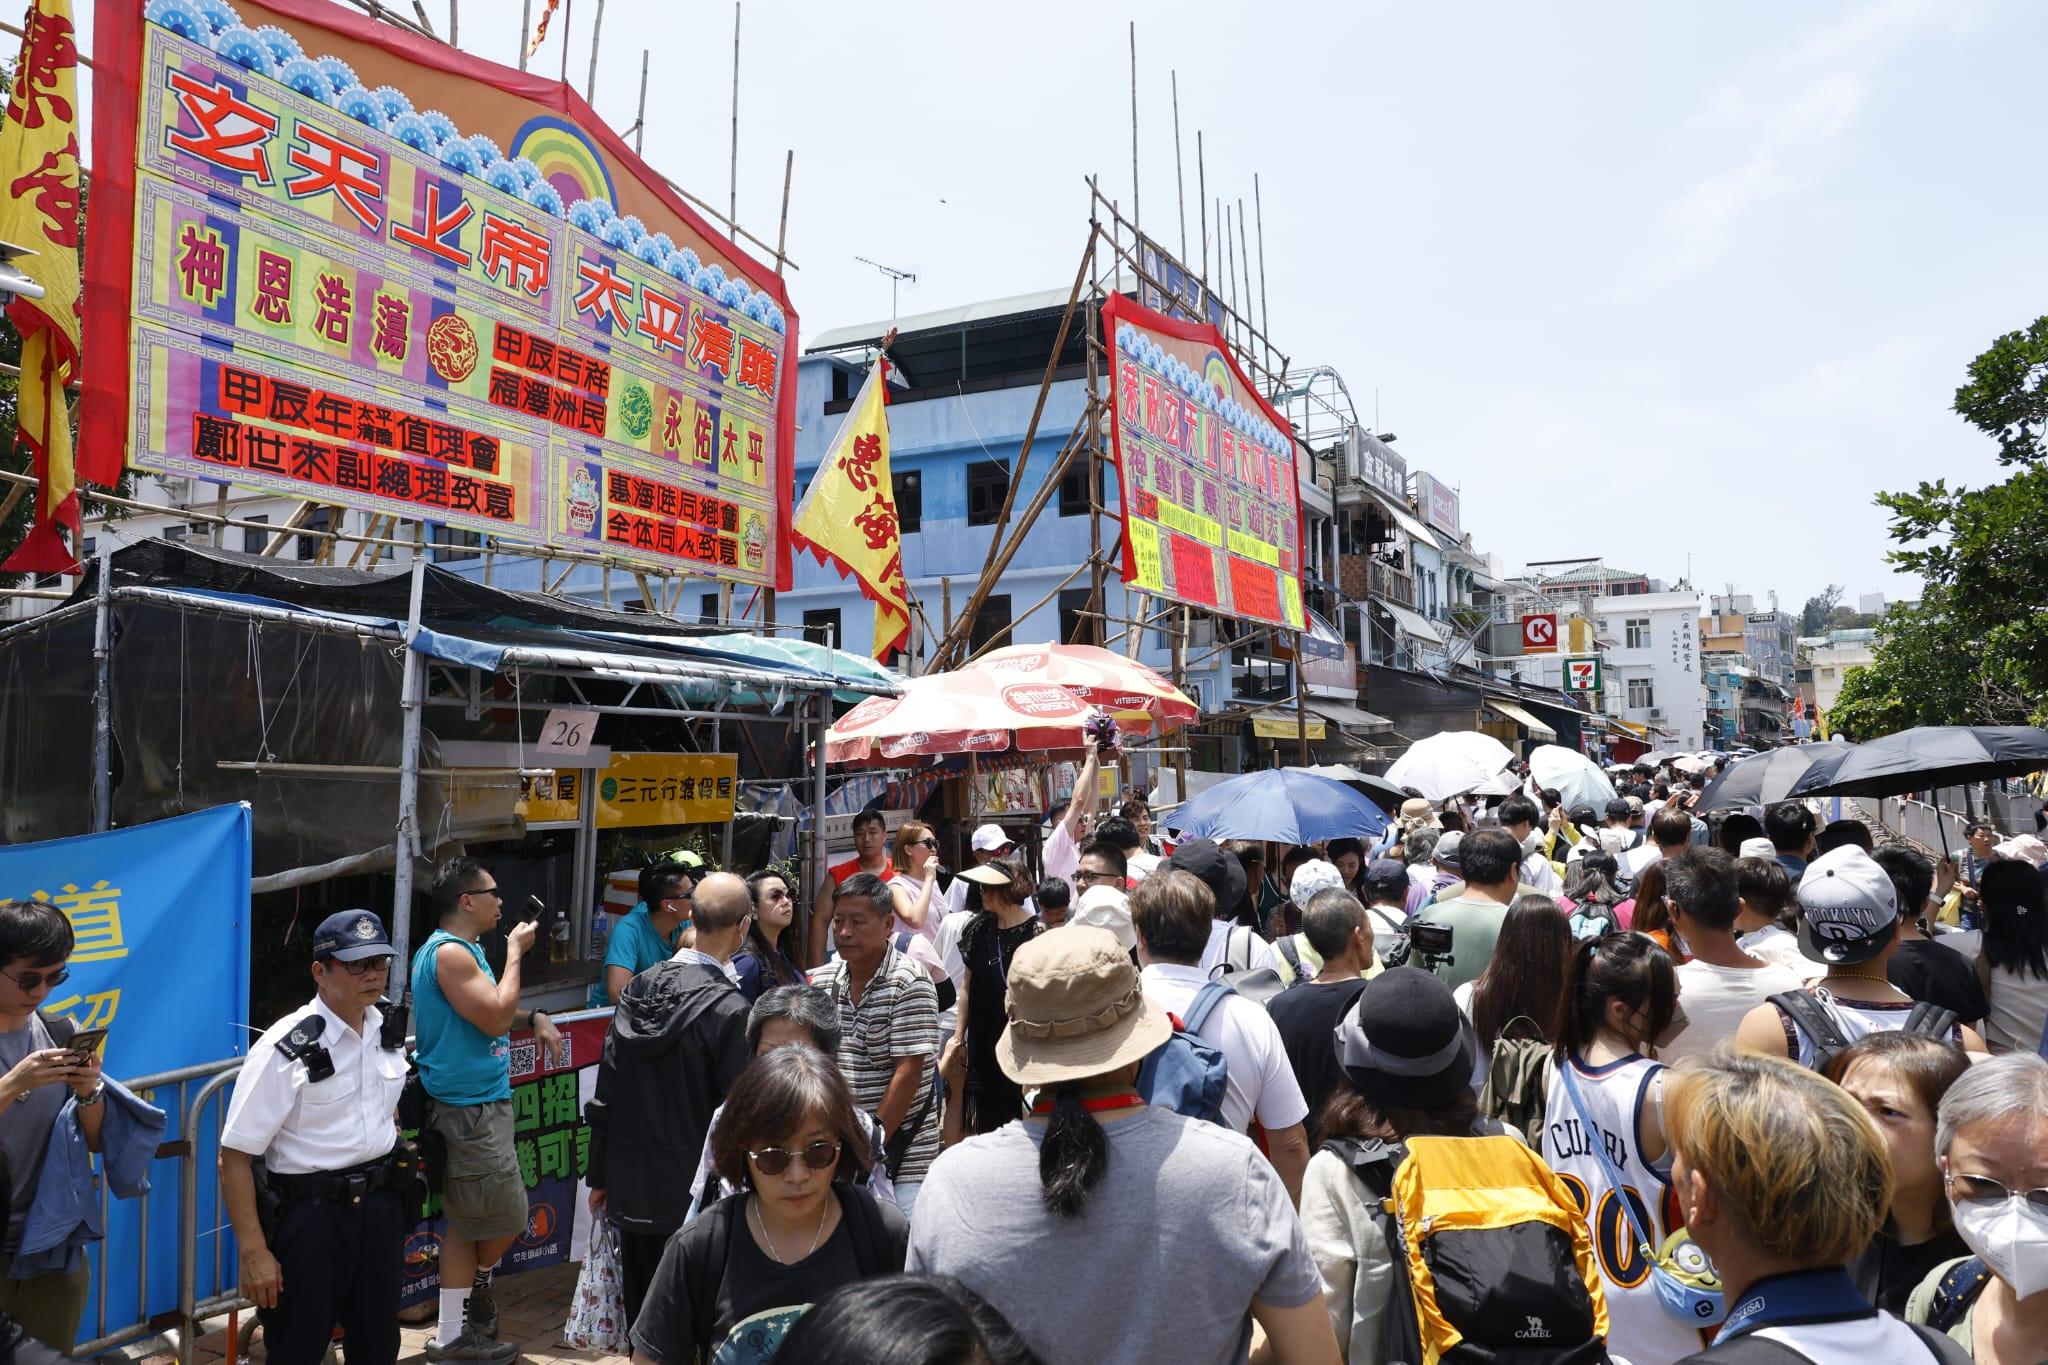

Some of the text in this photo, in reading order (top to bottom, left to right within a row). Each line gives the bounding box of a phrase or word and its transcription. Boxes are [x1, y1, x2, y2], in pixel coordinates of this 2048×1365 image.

[168, 67, 551, 295] 玄天上帝
[177, 224, 411, 362] 神恩浩蕩
[496, 324, 609, 396] 甲辰吉祥
[576, 258, 777, 399] 太平清醮
[490, 370, 606, 437] 福澤洲民
[194, 415, 514, 520] 鄺世來副總理致意
[662, 402, 764, 478] 永佑太平
[608, 472, 738, 532] 惠海陸同鄉會
[1533, 623, 1552, 641] K
[1572, 664, 1592, 689] 7
[550, 719, 582, 748] 26
[619, 776, 732, 804] 三元行渡假屋
[1514, 1329, 1553, 1339] CAMEL
